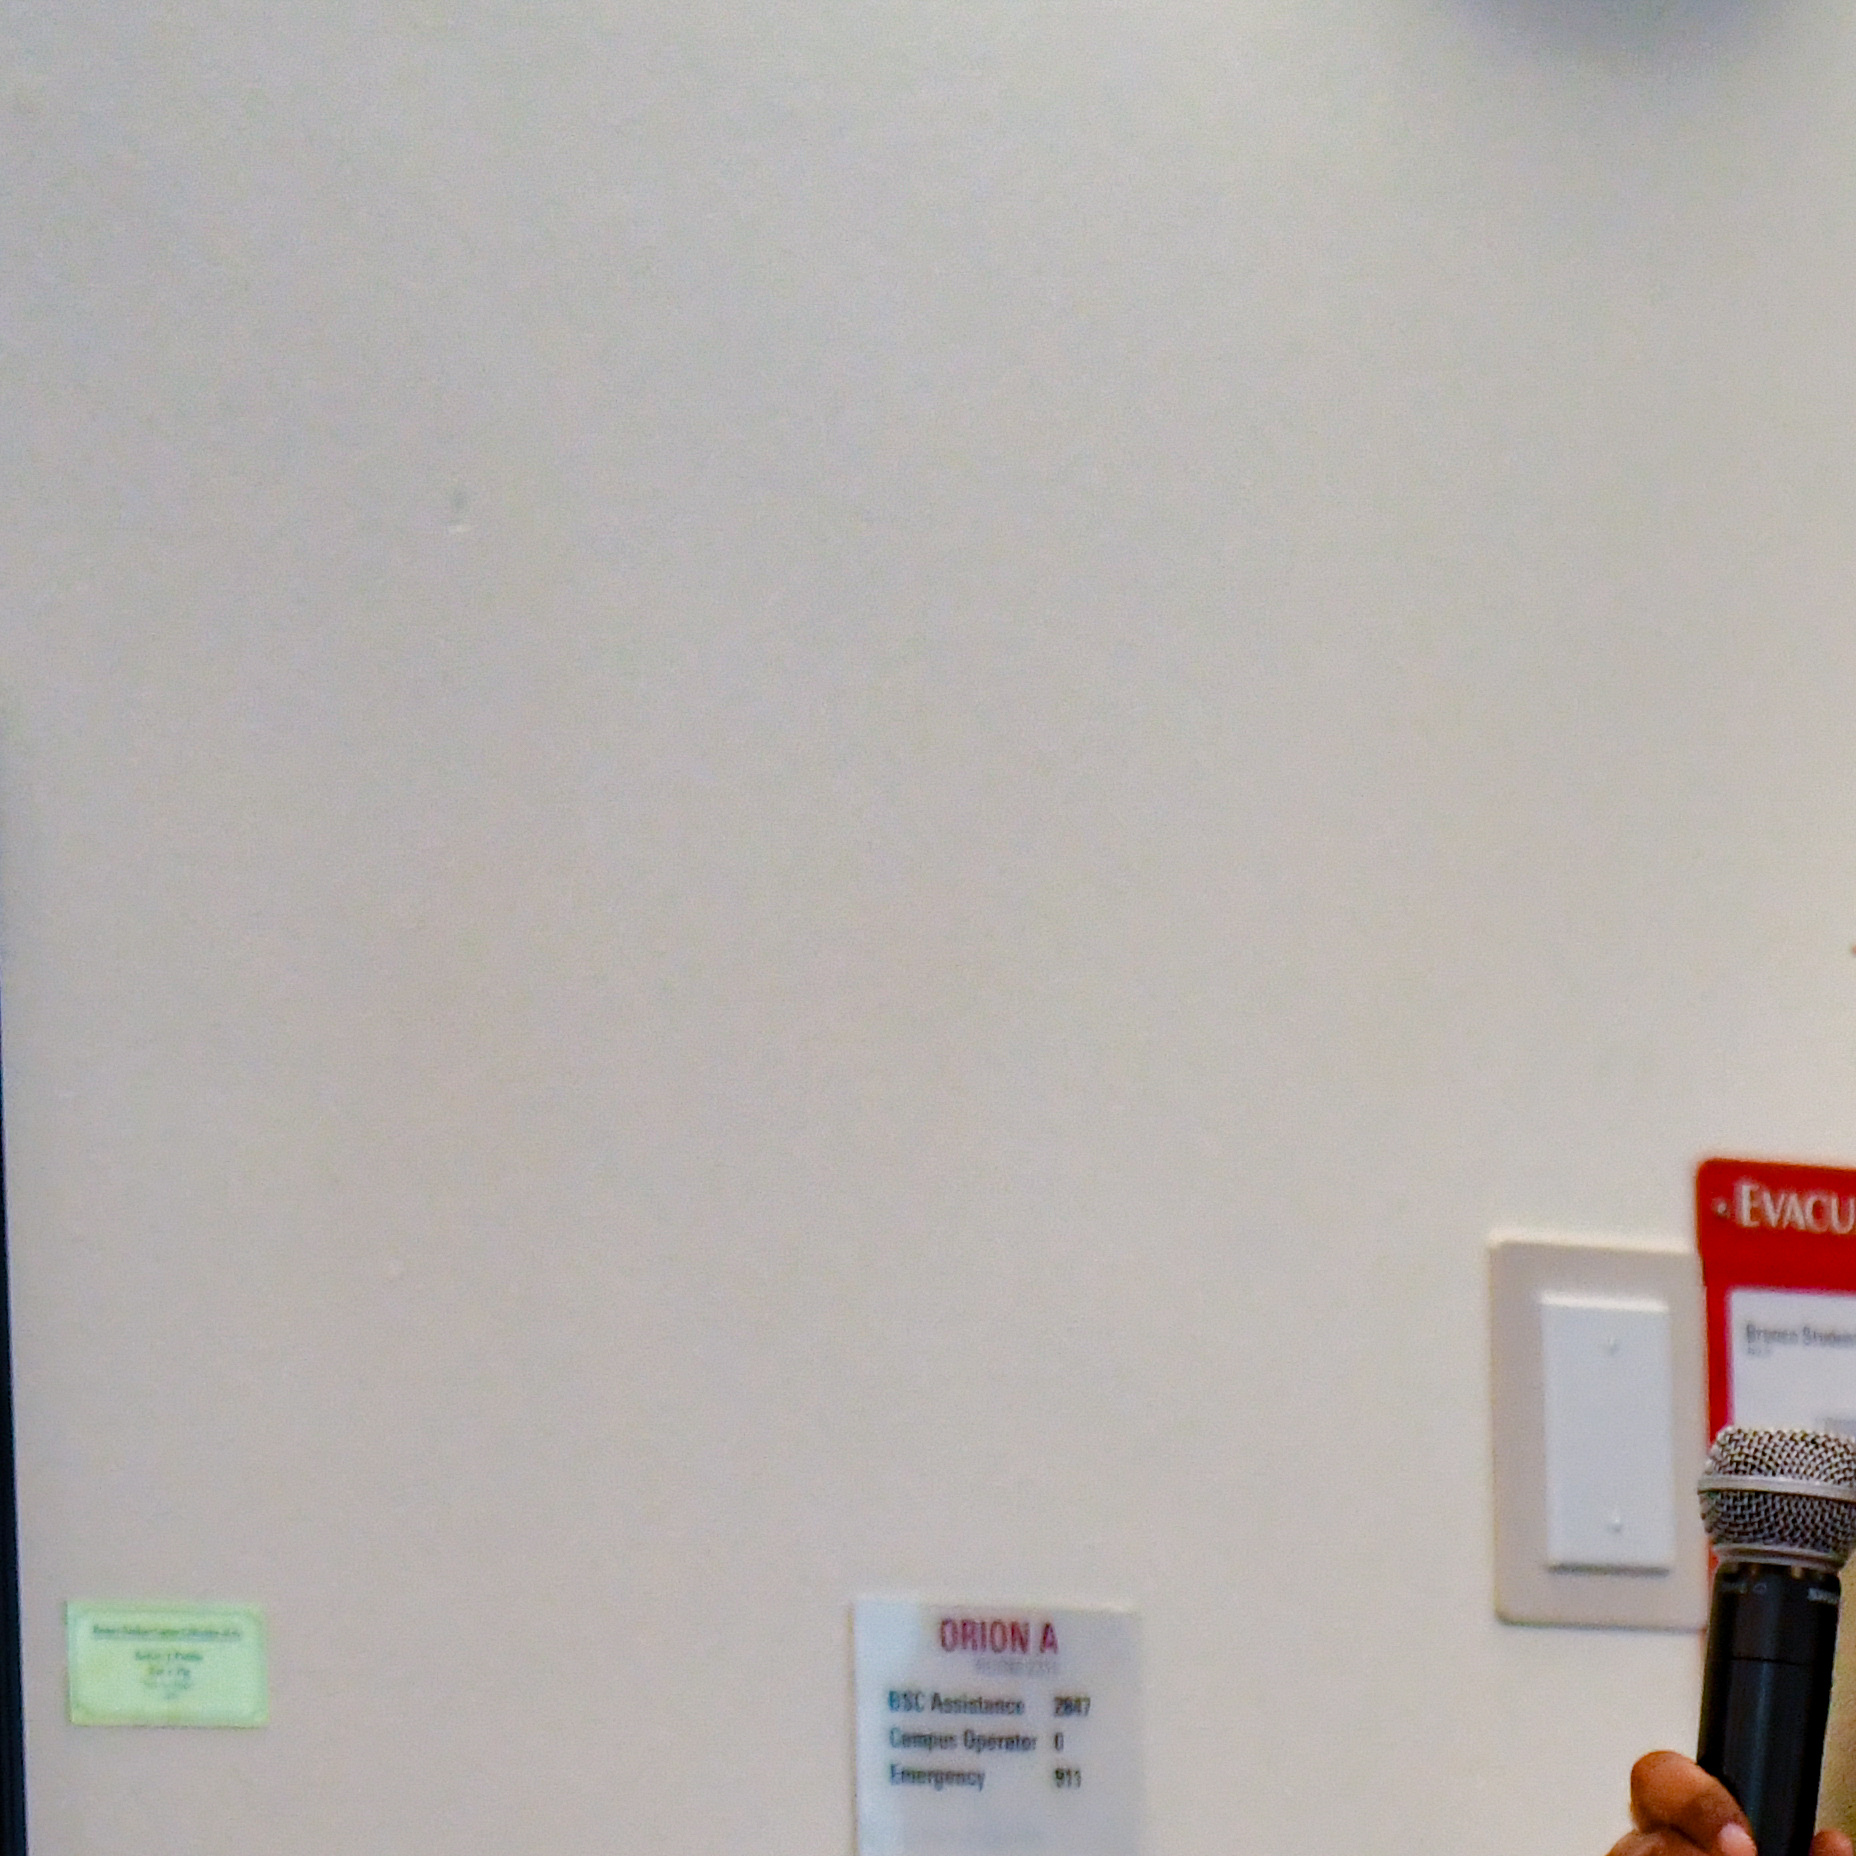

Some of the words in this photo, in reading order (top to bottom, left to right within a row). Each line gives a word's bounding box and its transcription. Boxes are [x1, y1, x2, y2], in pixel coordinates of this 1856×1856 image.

[939, 1618, 1030, 1654] ORION
[1039, 1621, 1059, 1654] A
[931, 1692, 1025, 1715] Assistance
[890, 1727, 957, 1751] Campus
[963, 1728, 1037, 1753] Operator
[890, 1763, 985, 1791] Emergency
[1054, 1767, 1081, 1788] 911
